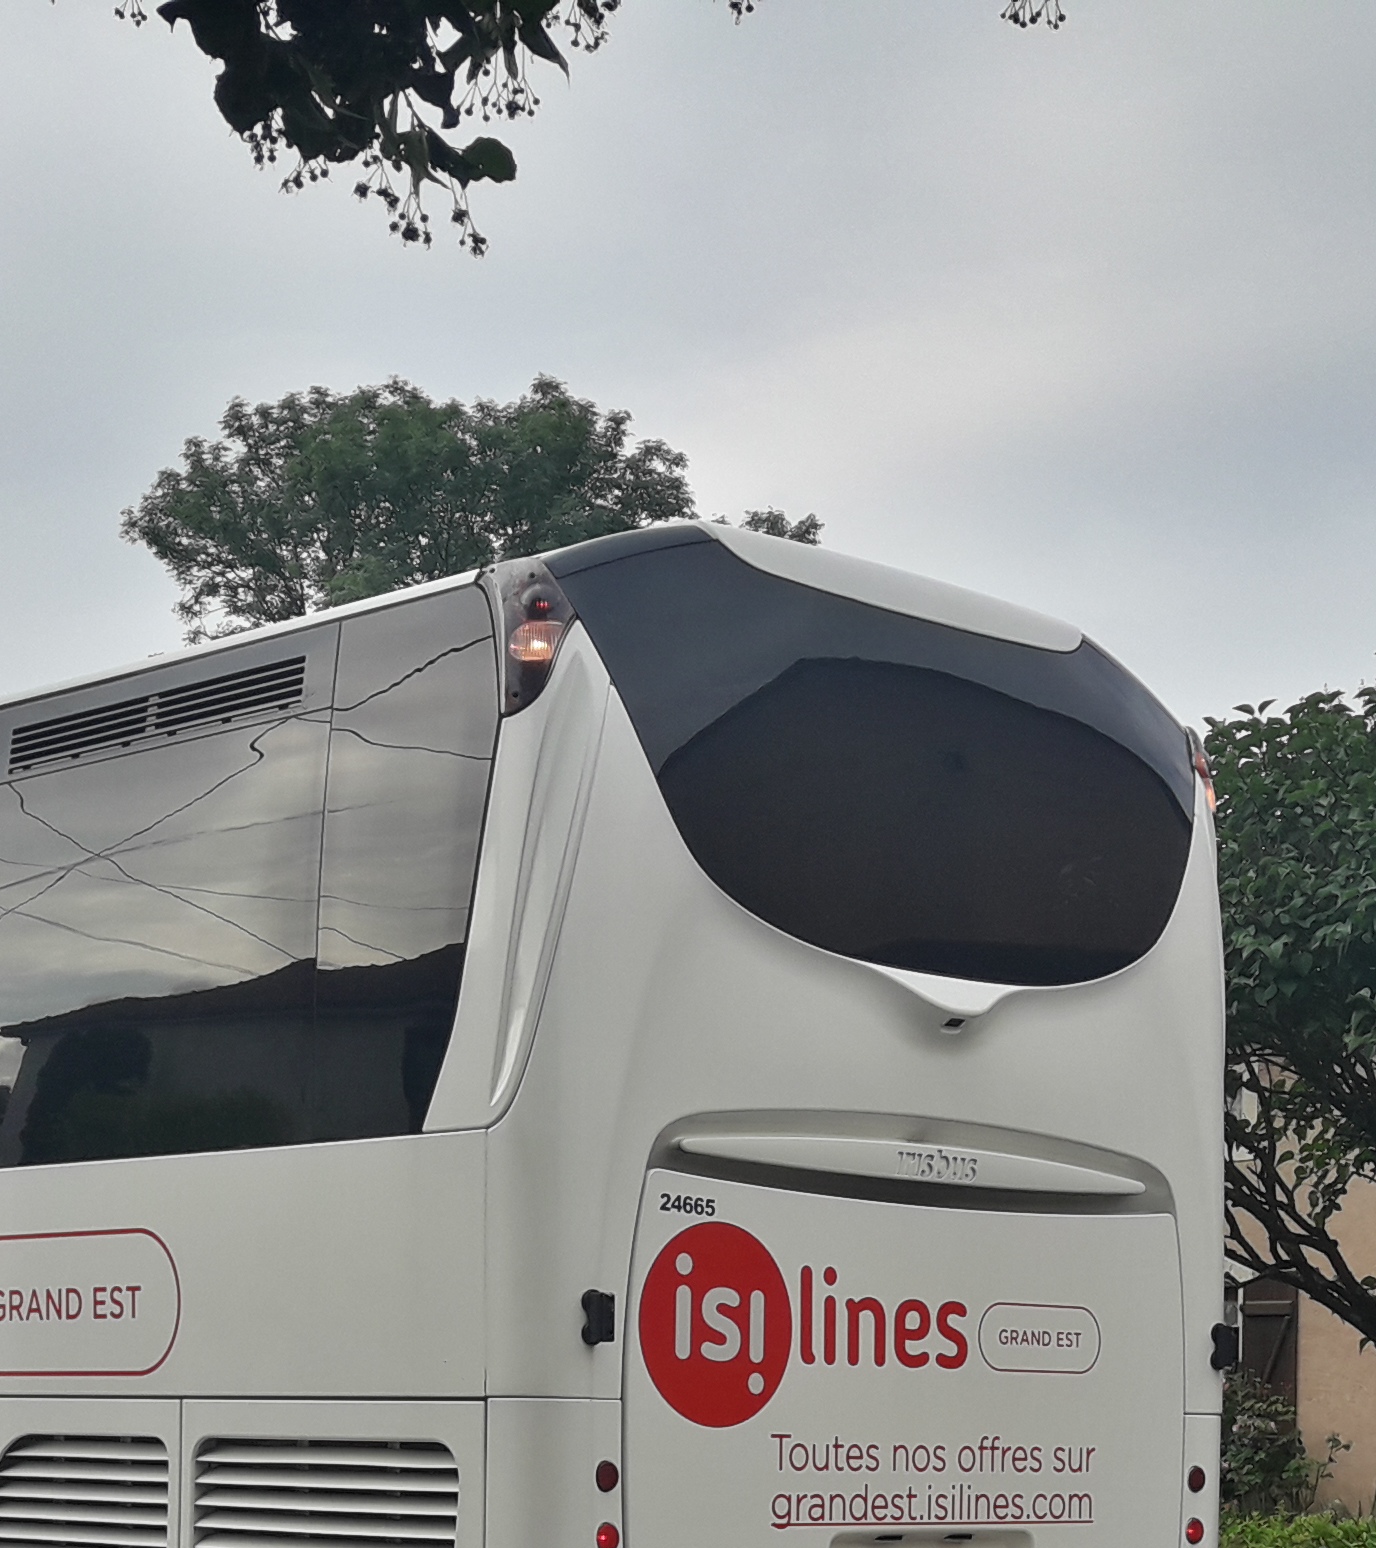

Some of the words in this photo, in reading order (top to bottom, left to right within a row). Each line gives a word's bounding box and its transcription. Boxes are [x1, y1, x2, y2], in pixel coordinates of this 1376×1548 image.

[659, 1193, 716, 1216] 24665
[92, 1285, 142, 1320] EST
[998, 1328, 1053, 1348] GRAND
[1055, 1331, 1082, 1349] EST
[770, 1433, 880, 1473] Toutes
[892, 1444, 947, 1473] nos
[957, 1435, 1043, 1474] offres
[1052, 1445, 1096, 1474] sur
[770, 1483, 1094, 1529] grandest.isilines.com
